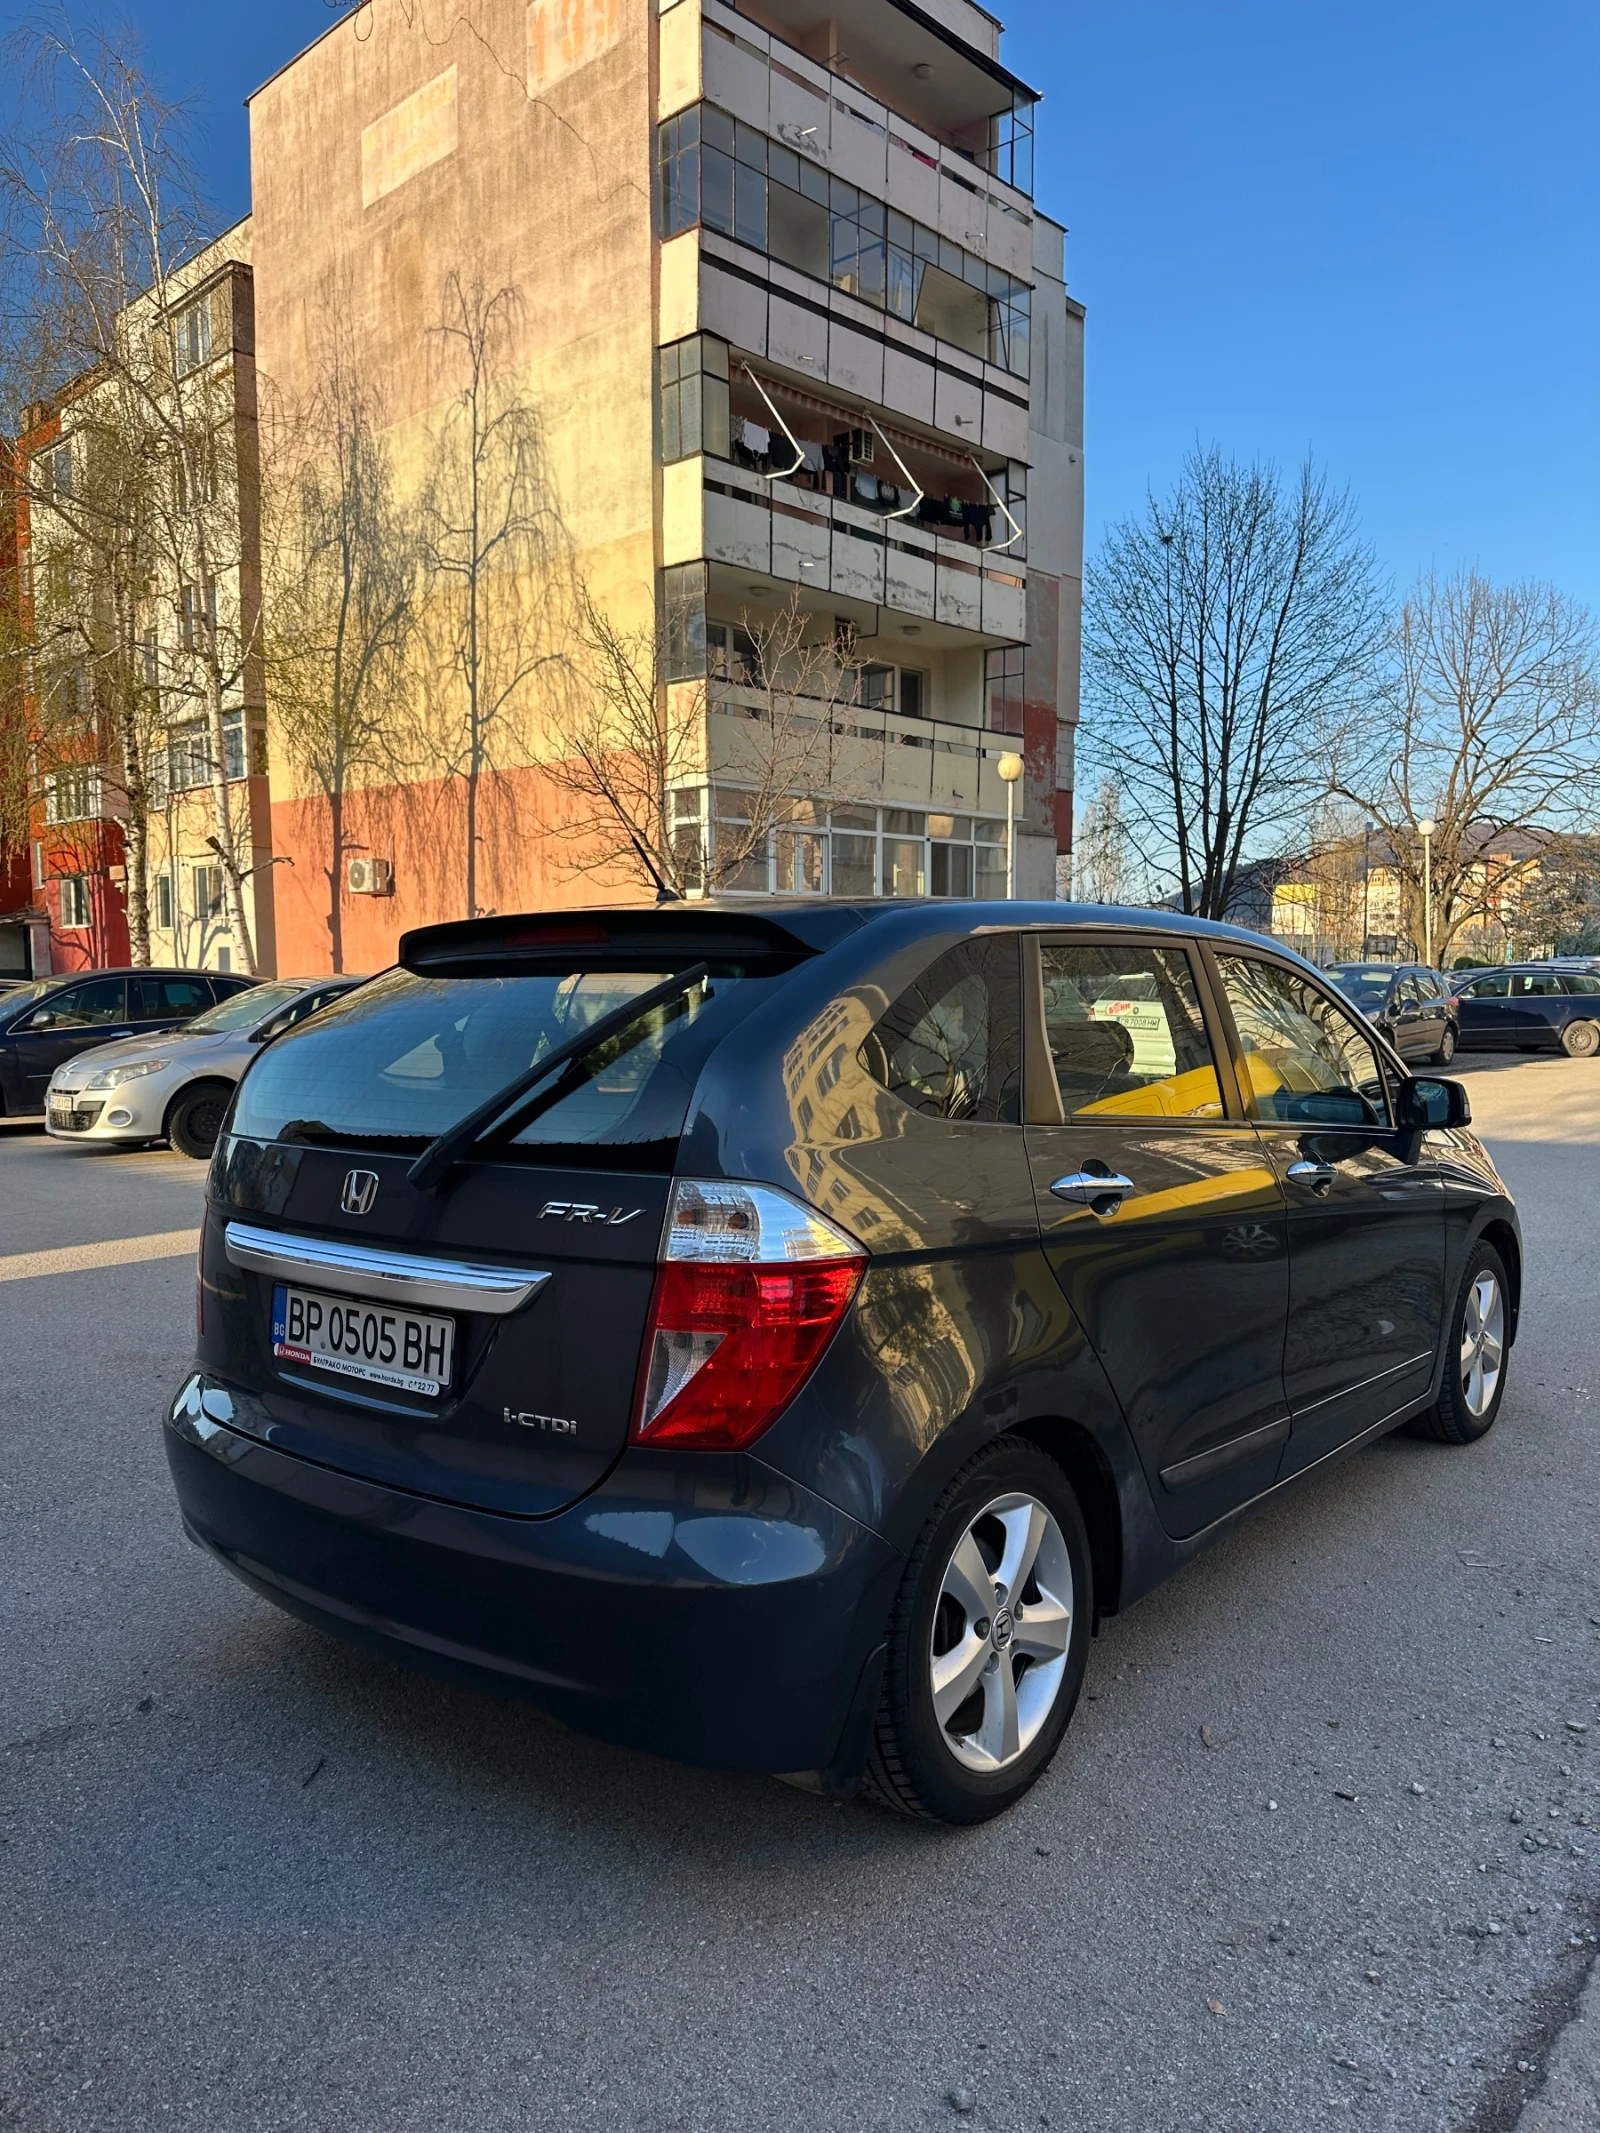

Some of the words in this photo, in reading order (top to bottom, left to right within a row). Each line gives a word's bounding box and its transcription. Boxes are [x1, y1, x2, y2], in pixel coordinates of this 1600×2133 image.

[536, 1201, 647, 1225] FR-V
[274, 1322, 285, 1337] BG
[288, 1296, 324, 1345] BP
[328, 1306, 397, 1364] 0505
[403, 1320, 447, 1377] BH
[285, 1349, 310, 1361] HONDA
[342, 1363, 366, 1377] МОТОРС
[369, 1371, 404, 1387] www.honda.bg
[503, 1407, 577, 1435] i-CTDi
